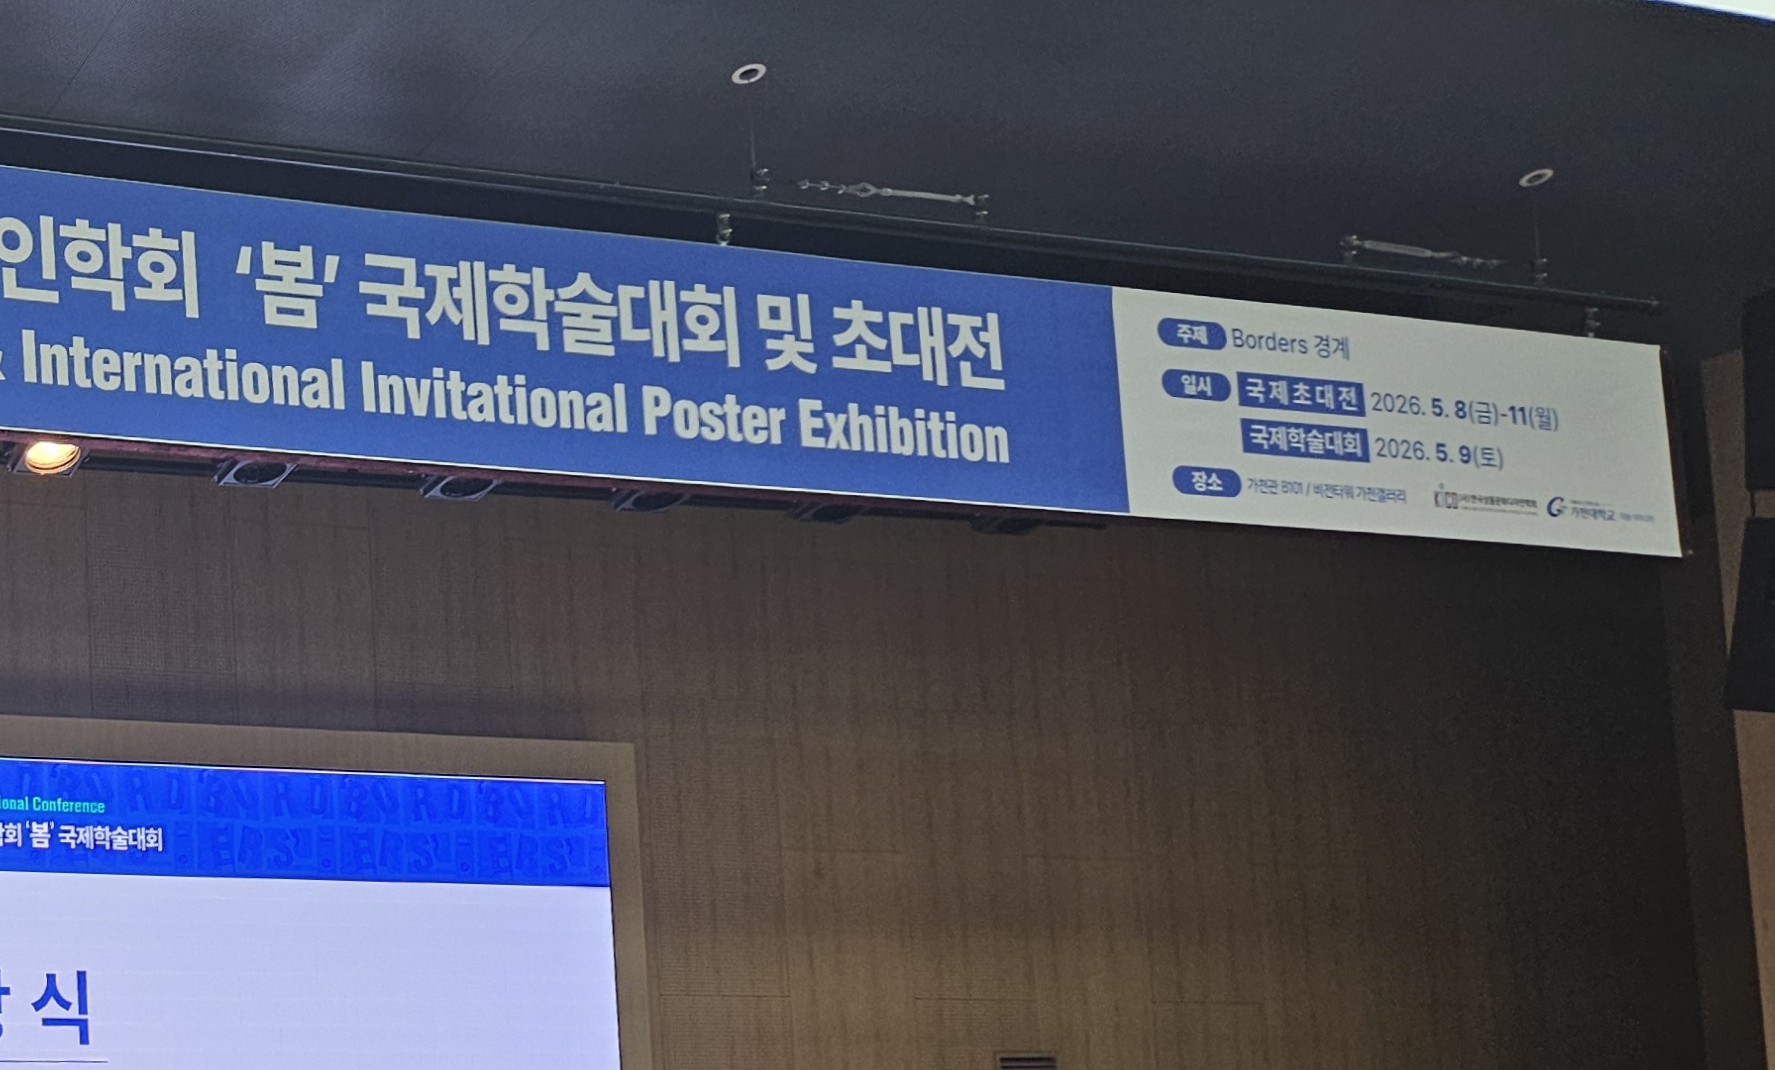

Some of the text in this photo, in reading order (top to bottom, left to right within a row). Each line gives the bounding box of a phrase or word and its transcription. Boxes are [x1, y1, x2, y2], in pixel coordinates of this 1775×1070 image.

[358, 253, 741, 368] 국제학술대회
[756, 293, 818, 374] 및
[831, 299, 1007, 391] 초대전
[1176, 323, 1209, 345] 주제
[1231, 327, 1350, 361] Borders 경계
[21, 329, 346, 410] International
[361, 360, 628, 433] Invitational
[641, 385, 786, 445] Poster
[798, 398, 1010, 463] Exhibition
[1180, 374, 1213, 397] 일시
[1371, 392, 1425, 416] 2026.
[1430, 397, 1449, 418] 5.
[1249, 424, 1363, 457] 국제학술대회
[1376, 437, 1430, 461] 2026.
[1434, 442, 1453, 463] 5.
[1191, 470, 1224, 492] 장소
[32, 796, 106, 814] Conference
[57, 824, 163, 852] 국제학술대회
